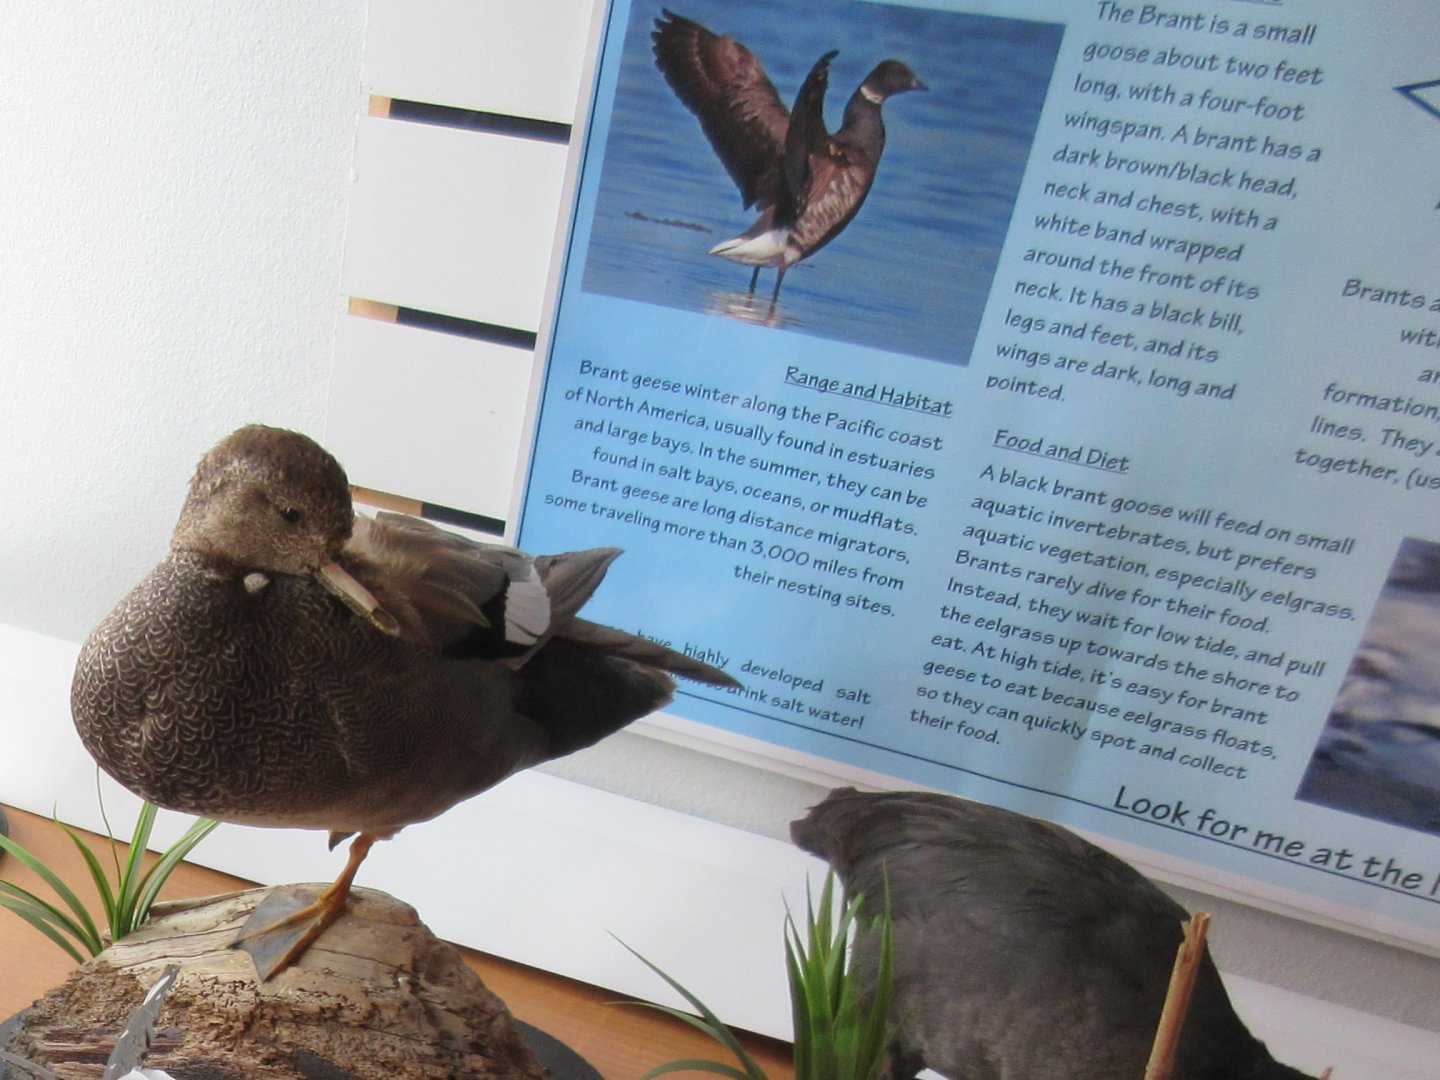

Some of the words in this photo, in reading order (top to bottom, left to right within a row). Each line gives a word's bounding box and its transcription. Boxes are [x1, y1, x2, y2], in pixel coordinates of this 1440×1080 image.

[1098, 0, 1134, 23] The
[1138, 5, 1205, 31] Brant
[1209, 14, 1229, 34] is
[1232, 22, 1249, 37] a
[1253, 24, 1317, 45] small
[1083, 43, 1150, 63] goose
[1152, 46, 1219, 71] about
[1225, 57, 1269, 79] two
[1274, 60, 1323, 85] feet
[1074, 72, 1120, 102] long,
[1129, 84, 1176, 104] with
[1179, 93, 1194, 107] a
[1199, 89, 1305, 122] four-foot
[1065, 111, 1164, 143] wingspan.
[1170, 124, 1188, 144] A
[1192, 126, 1257, 153] brant
[1260, 136, 1302, 159] has
[1306, 148, 1322, 162] a
[1053, 144, 1101, 168] dark
[1104, 150, 1236, 188] brown/black
[1238, 171, 1297, 200] head,
[1043, 182, 1091, 201] neck
[1093, 190, 1135, 208] and
[1136, 194, 1203, 222] chest,
[1211, 207, 1260, 228] with
[1262, 217, 1278, 230] a
[1035, 213, 1091, 237] white
[1094, 221, 1147, 246] band
[1150, 236, 1245, 264] wrapped
[1023, 249, 1096, 272] around
[1099, 259, 1135, 280] the
[1139, 264, 1195, 289] front
[1199, 275, 1227, 294] of
[1226, 279, 1259, 300] its
[1342, 279, 1425, 309] Brants
[1014, 281, 1063, 302] neck.
[1069, 286, 1087, 306] It
[1091, 290, 1128, 313] has
[1131, 303, 1146, 316] a
[1149, 300, 1205, 326] black
[1208, 310, 1243, 336] bill,
[1004, 308, 1045, 334] legs
[1048, 322, 1088, 339] and
[1091, 324, 1138, 352] feet,
[1143, 339, 1186, 357] and
[1187, 342, 1219, 363] its
[1400, 328, 1440, 348] wit
[785, 366, 840, 395] Range
[843, 380, 875, 401] and
[880, 386, 953, 416] Habitat
[986, 375, 1065, 402] pointed.
[996, 343, 1051, 368] wings
[1054, 356, 1088, 373] are
[1091, 360, 1142, 386] dark,
[1147, 368, 1192, 397] long
[1194, 383, 1237, 400] and
[579, 359, 629, 383] Brant
[632, 375, 682, 393] geese
[685, 384, 739, 405] winter
[741, 394, 787, 421] along
[792, 405, 821, 424] the
[825, 412, 885, 439] Pacific
[888, 430, 943, 451] coast
[994, 429, 1044, 454] Food
[1045, 440, 1082, 462] and
[1085, 448, 1130, 473] Diet
[1310, 415, 1366, 442] lines.
[1381, 428, 1434, 458] They
[1295, 448, 1398, 484] together,
[979, 464, 994, 482] A
[999, 467, 1049, 493] black
[1052, 479, 1108, 505] brant
[1110, 498, 1174, 518] goose
[1178, 509, 1212, 526] will
[1214, 512, 1263, 536] feed
[1264, 527, 1292, 542] on
[1295, 534, 1356, 555] small
[545, 494, 587, 512] some
[591, 502, 661, 533] traveling
[664, 521, 705, 541] more
[709, 531, 747, 552] than
[751, 539, 810, 566] 3,000
[812, 559, 858, 579] miles
[862, 567, 904, 590] from
[734, 565, 775, 585] their
[777, 578, 842, 607] nesting
[845, 594, 895, 617] sites.
[962, 526, 1035, 551] aquatic
[1039, 543, 1149, 578] vegetation,
[1155, 568, 1258, 602] especially
[1260, 591, 1355, 621] eelgrass.
[740, 659, 824, 693] developed
[836, 688, 872, 705] salt
[771, 697, 804, 713] salt
[808, 706, 865, 729] water!
[1113, 785, 1190, 827] Look
[1197, 808, 1248, 841] for
[1252, 830, 1306, 857] me
[1309, 848, 1354, 871] at
[1362, 856, 1424, 890] the
